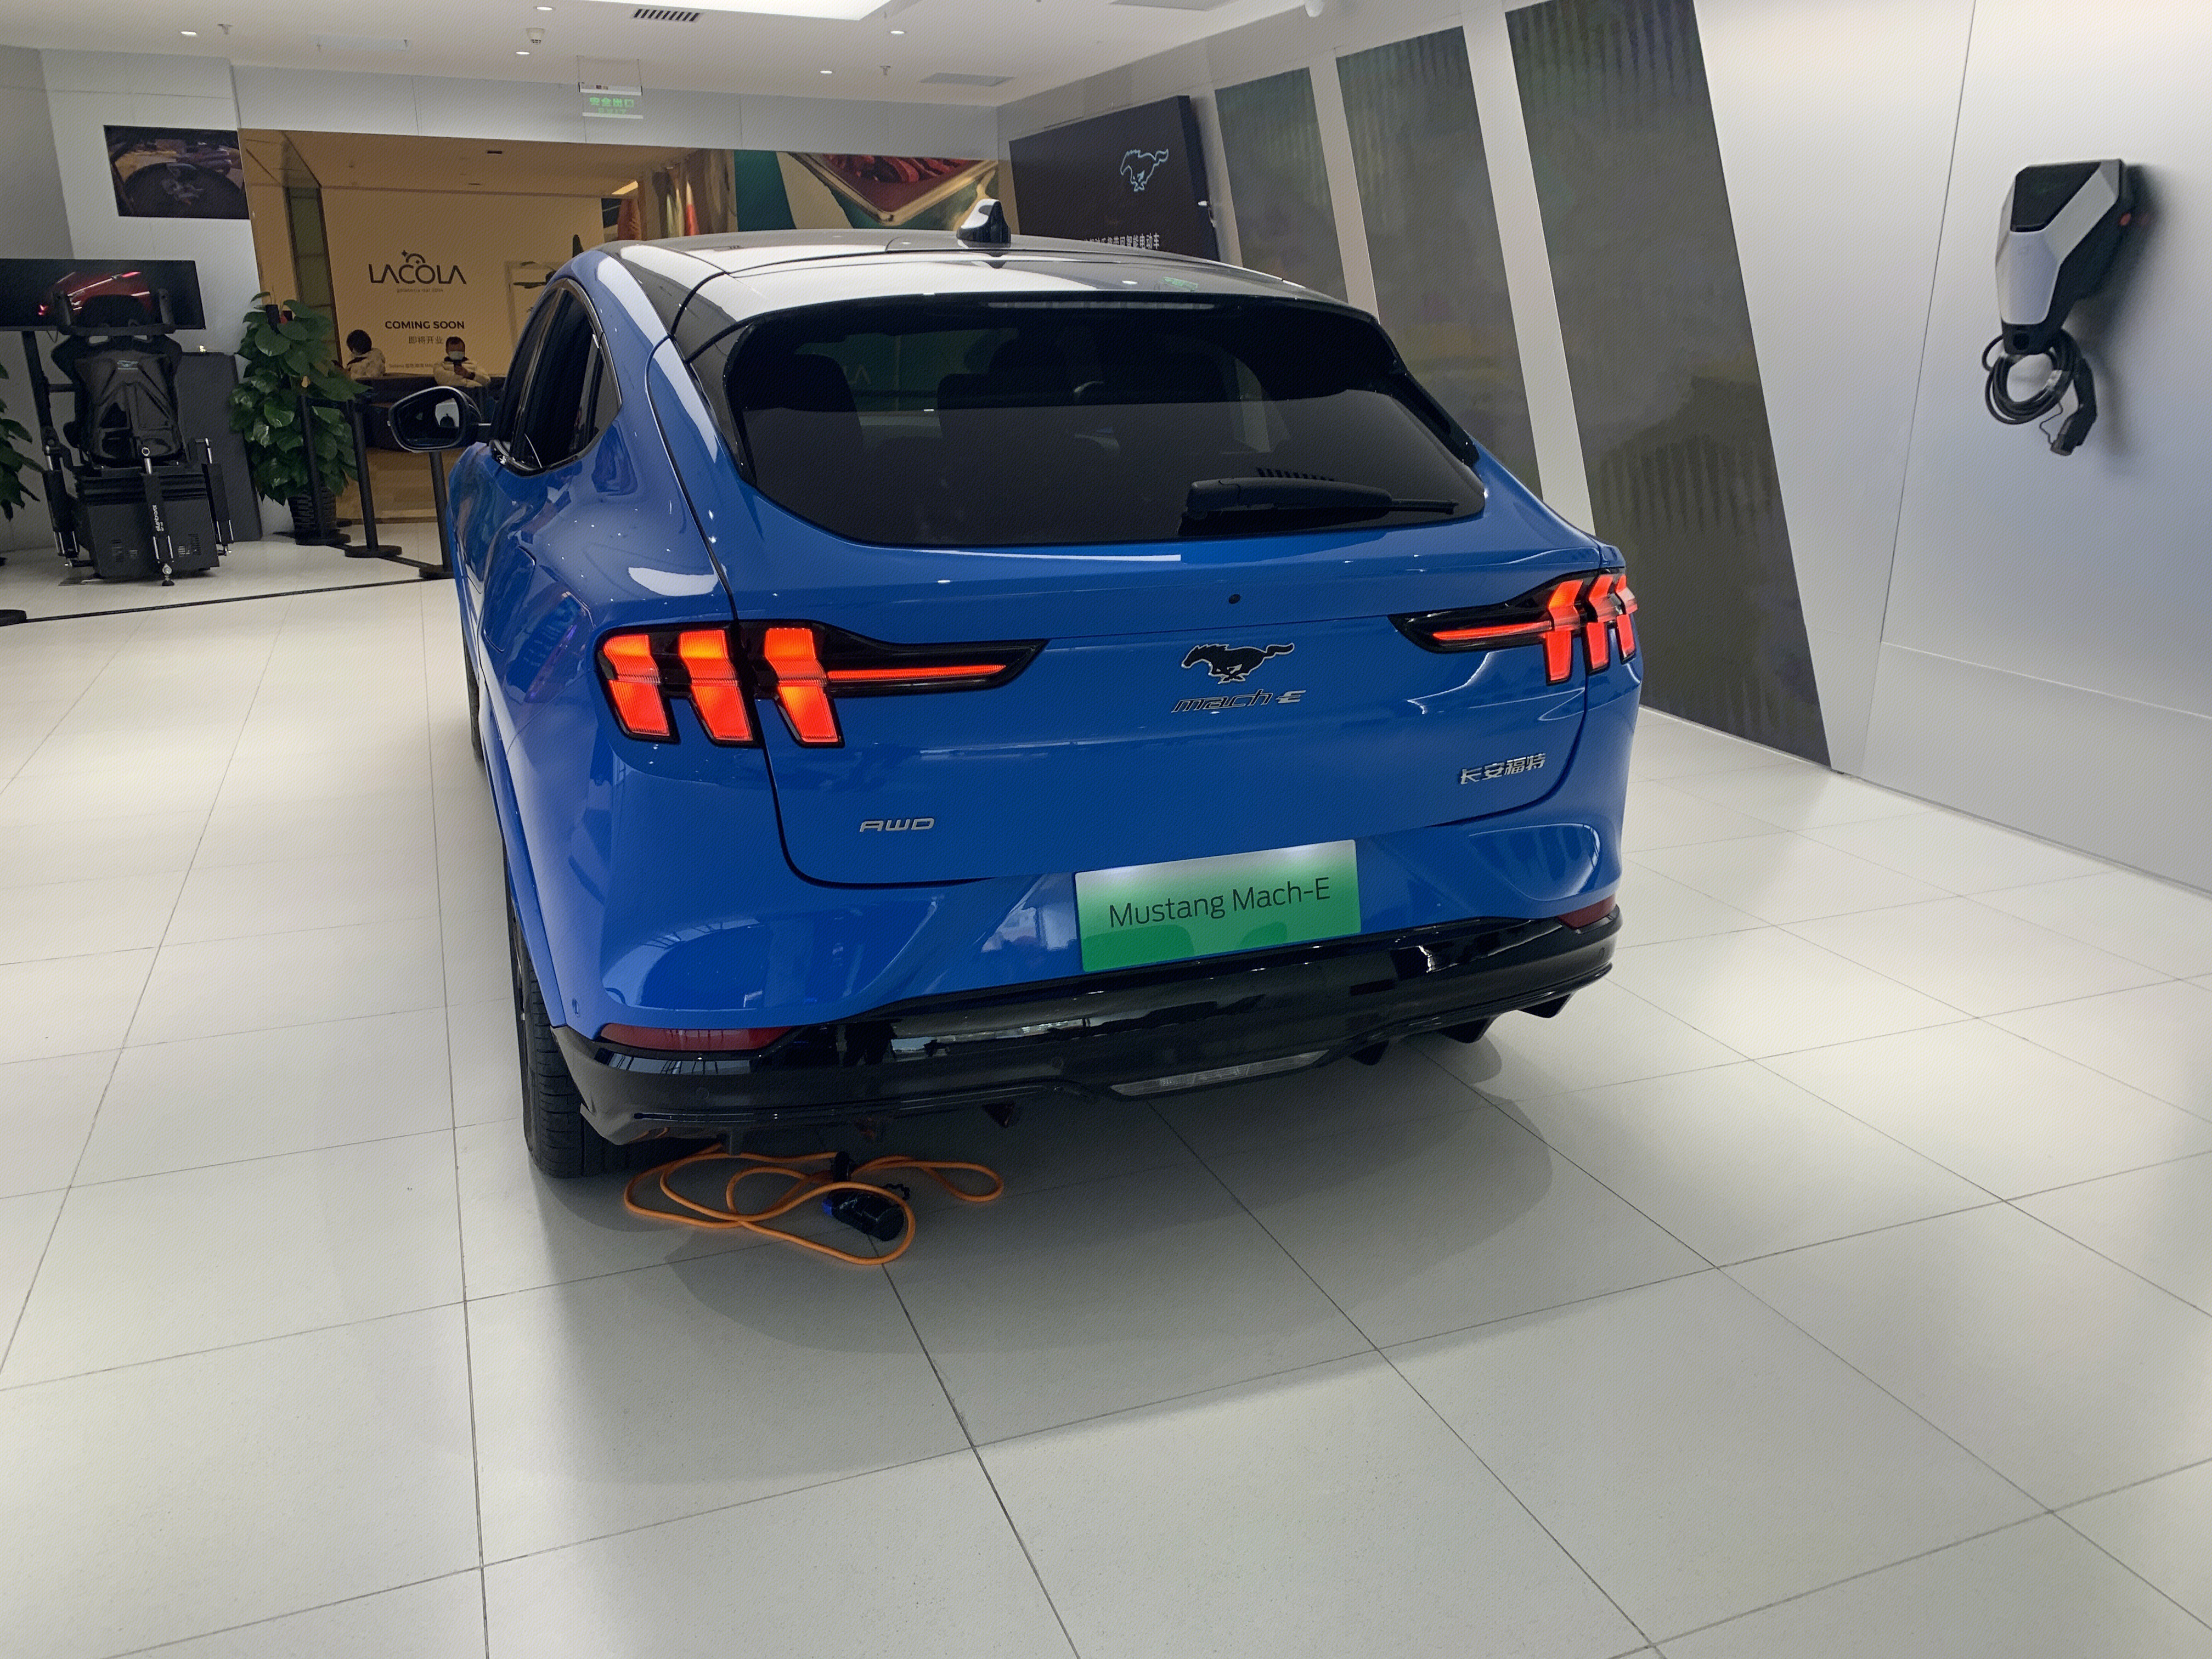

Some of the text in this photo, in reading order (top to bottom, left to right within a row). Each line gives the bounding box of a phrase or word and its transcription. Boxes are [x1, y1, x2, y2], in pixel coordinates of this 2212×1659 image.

[589, 97, 634, 108] 安全出口
[368, 263, 466, 284] LACOLA
[385, 321, 465, 329] COMING SOON
[409, 336, 444, 345] 即将开业
[1460, 753, 1546, 785] 长安福特
[859, 817, 935, 832] AWD
[1109, 877, 1330, 928] Mustang Mach-E
